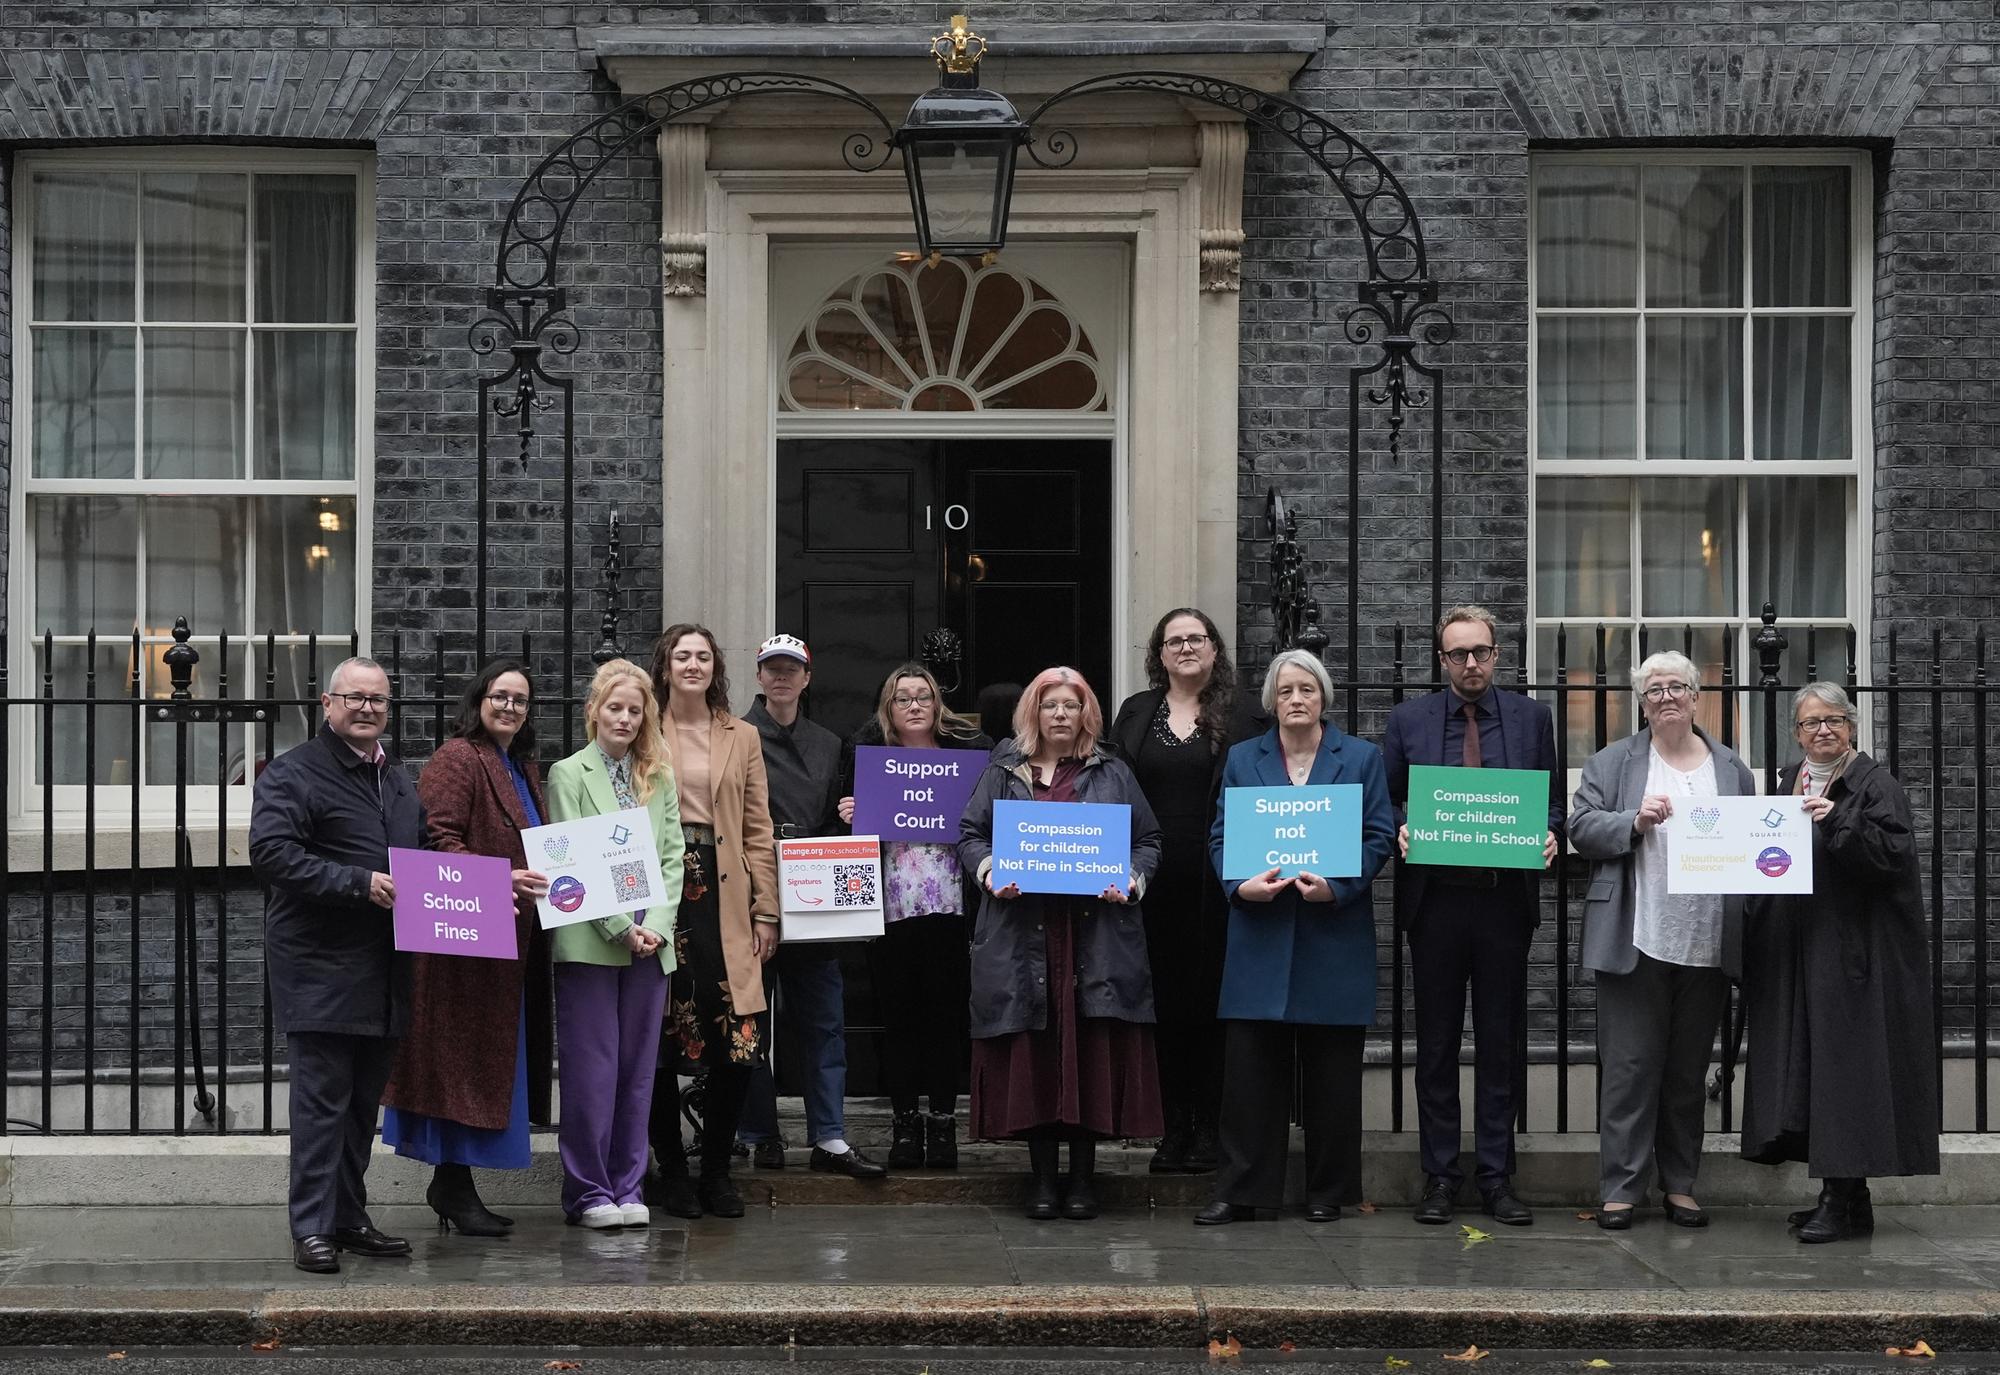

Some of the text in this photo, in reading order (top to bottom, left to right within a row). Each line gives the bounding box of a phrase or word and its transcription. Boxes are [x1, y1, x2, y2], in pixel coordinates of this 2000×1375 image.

[926, 505, 969, 530] 10
[884, 758, 960, 780] Support
[903, 787, 934, 803] not
[1433, 789, 1520, 805] Compassion
[1255, 796, 1331, 817] Support
[893, 812, 946, 830] Court
[1435, 809, 1516, 825] for children
[1017, 821, 1102, 837] Compassion
[1275, 824, 1306, 840] not
[1413, 830, 1540, 846] Not Fine in School
[1019, 840, 1100, 855] for children
[1265, 849, 1319, 866] Court
[438, 865, 463, 883] No
[999, 858, 1124, 875] Not Fine in School
[787, 878, 822, 887] Signatures
[423, 893, 482, 913] School
[434, 922, 479, 942] Fines
